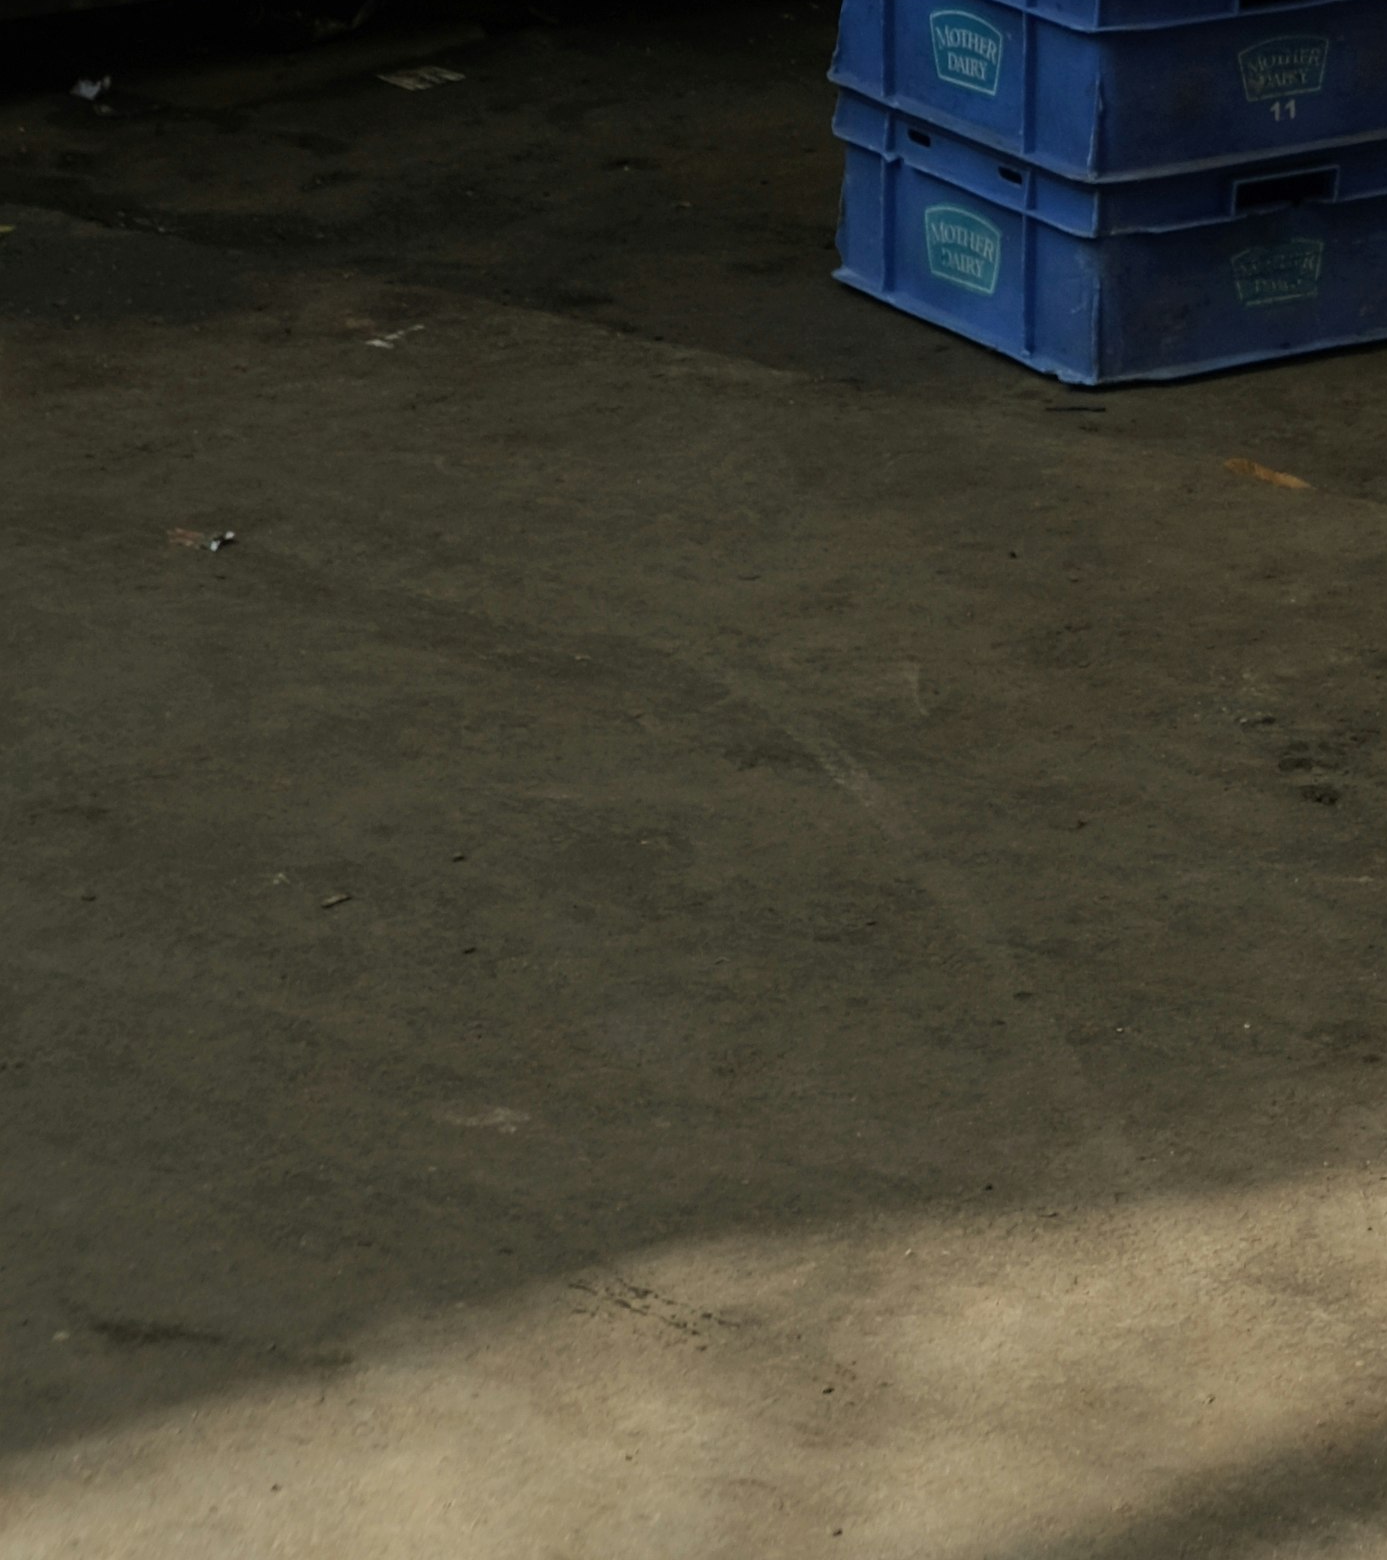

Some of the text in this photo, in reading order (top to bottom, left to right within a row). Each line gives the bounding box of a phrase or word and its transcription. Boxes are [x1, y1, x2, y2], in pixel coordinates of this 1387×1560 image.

[936, 23, 1000, 70] MOTHER
[947, 51, 989, 84] DAIRY
[1270, 101, 1297, 122] 11
[931, 222, 997, 266] MOTHER
[942, 248, 986, 280] DAIRY
